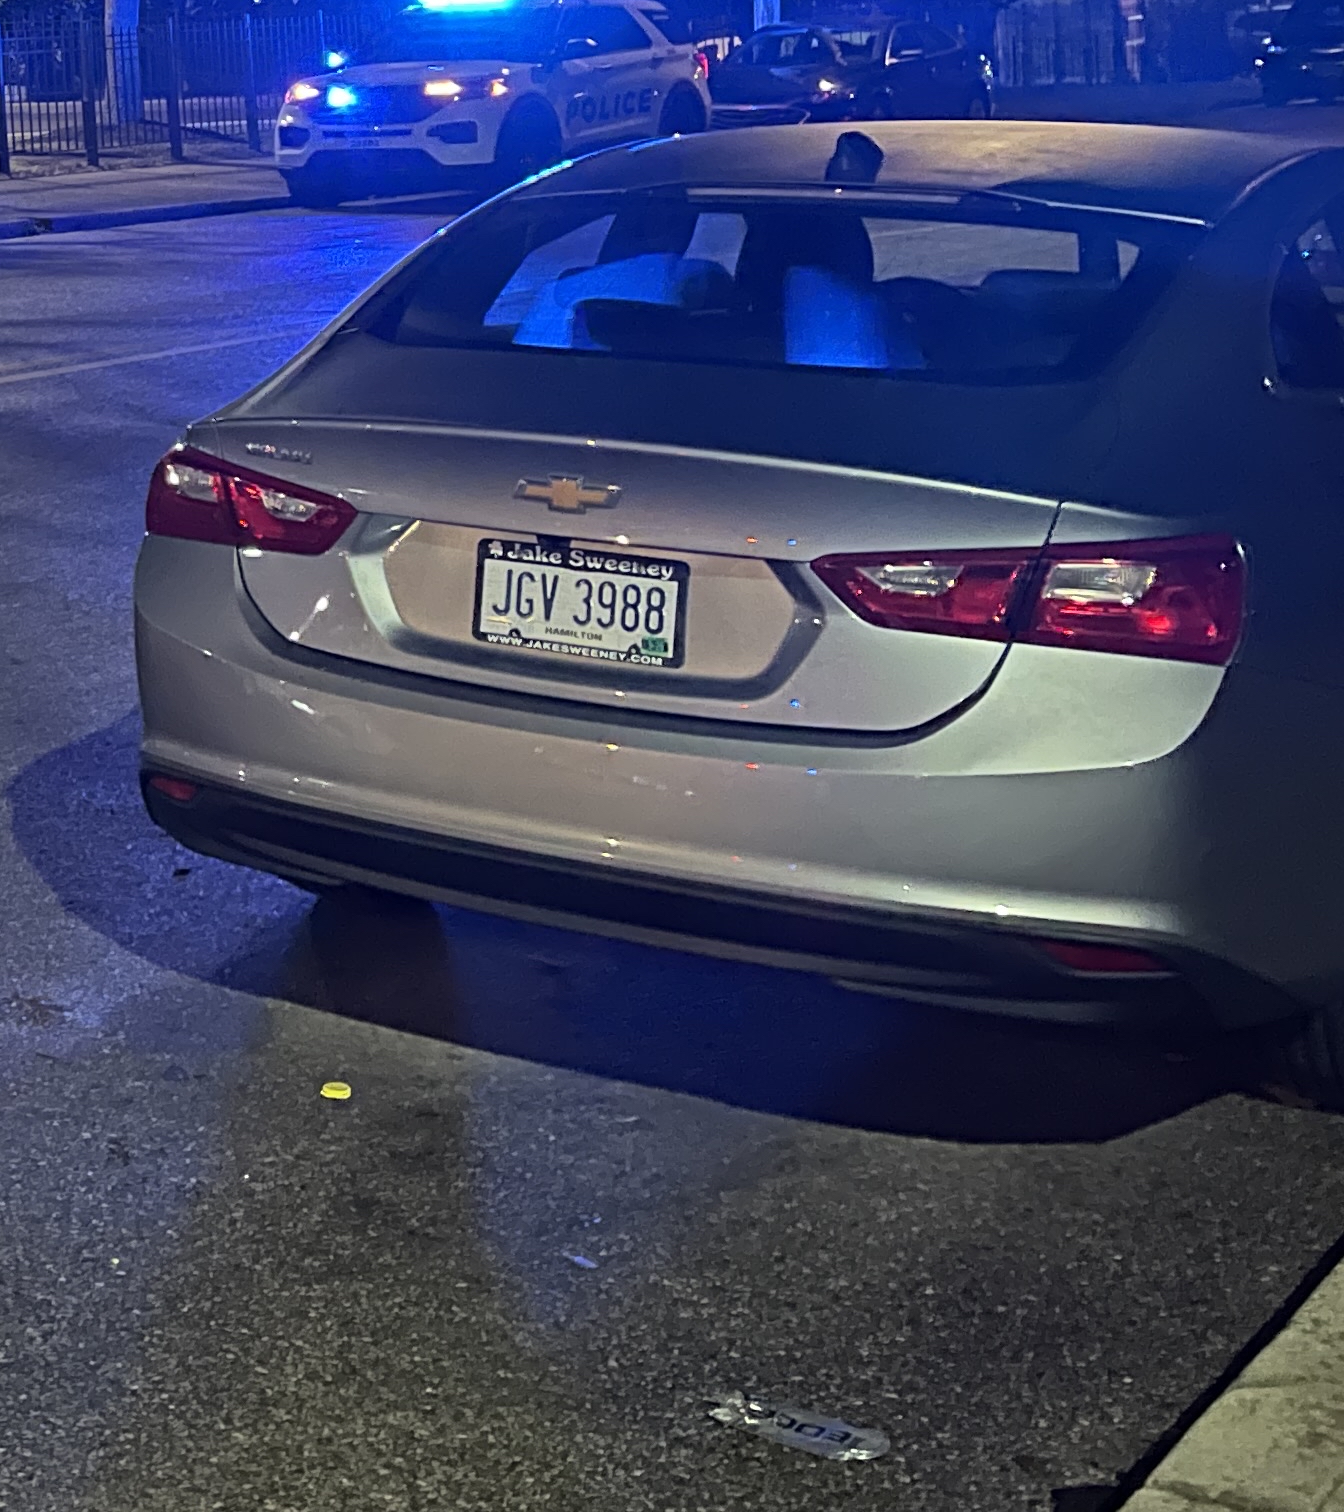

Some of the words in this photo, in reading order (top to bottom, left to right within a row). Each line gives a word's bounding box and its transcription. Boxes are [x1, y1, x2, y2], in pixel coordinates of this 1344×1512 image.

[566, 88, 652, 125] POLICE
[507, 543, 563, 565] Jake
[568, 549, 674, 581] Sweeney
[491, 568, 560, 622] JGV
[572, 578, 666, 635] 3988
[487, 633, 663, 666] WWW.JAKESWEENEY.COM
[544, 626, 604, 642] HAMILTON
